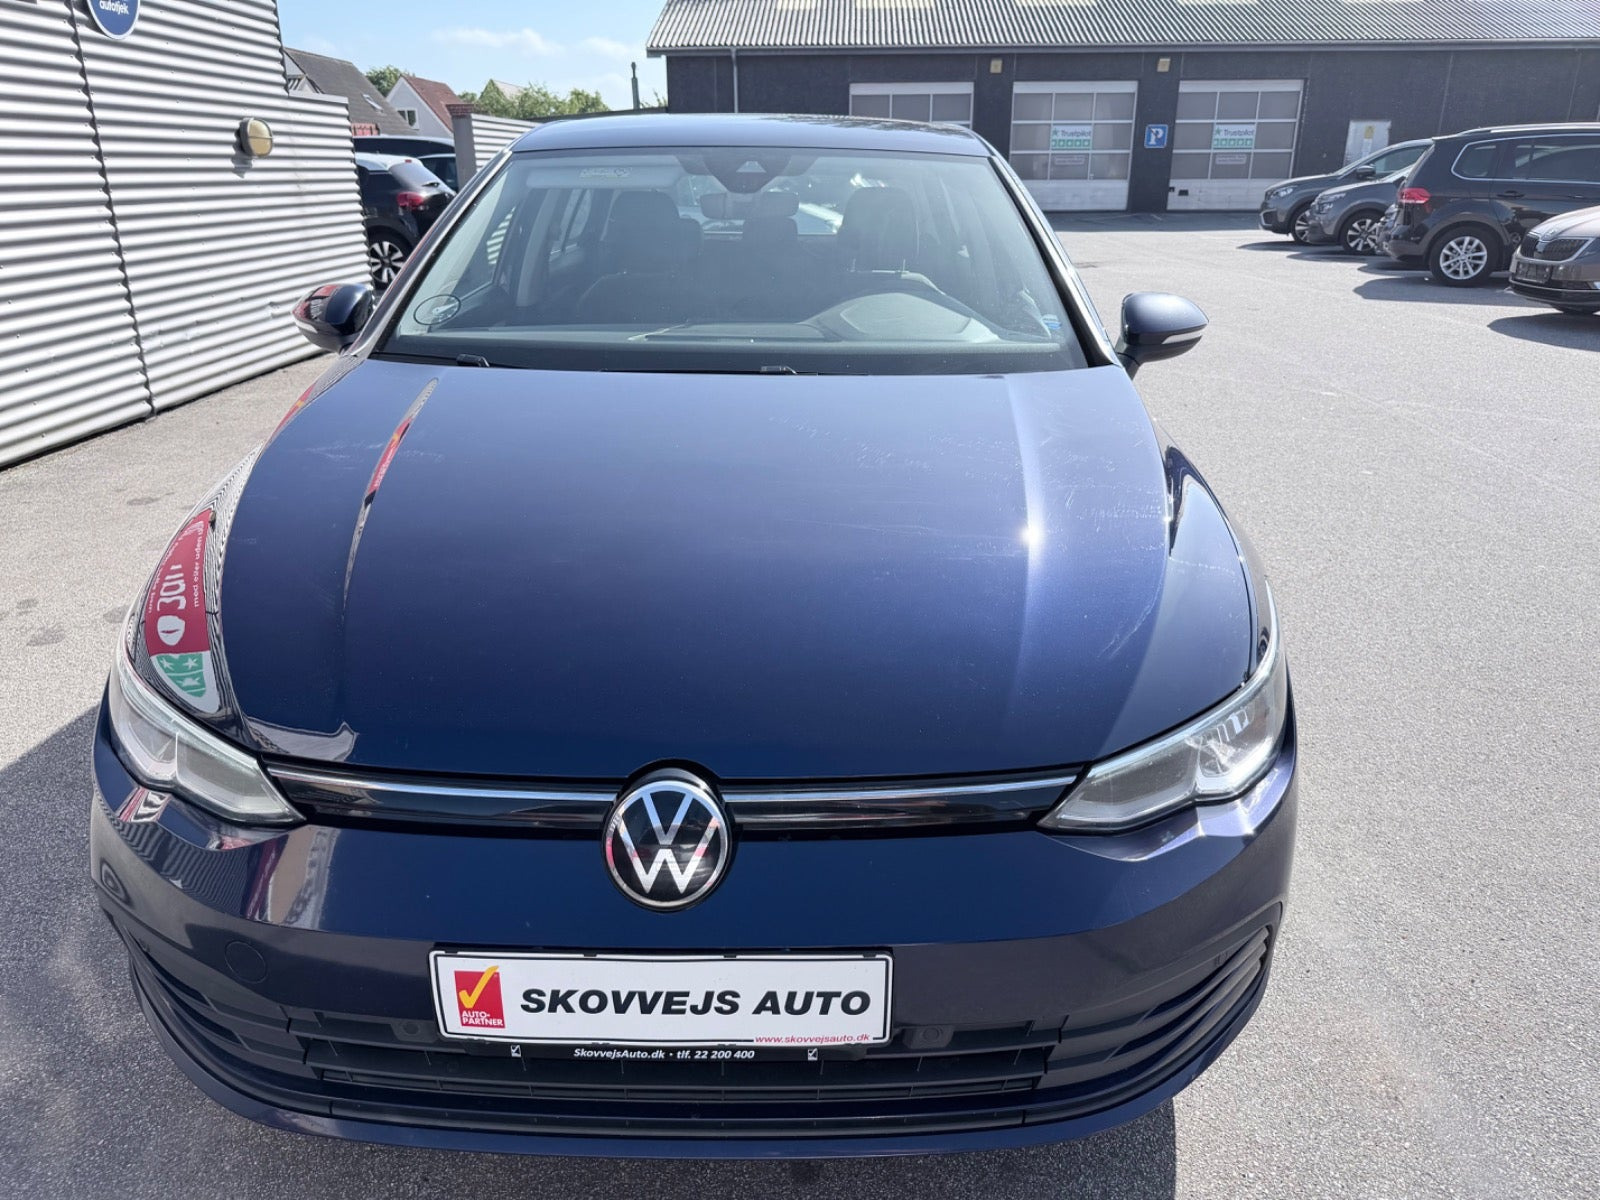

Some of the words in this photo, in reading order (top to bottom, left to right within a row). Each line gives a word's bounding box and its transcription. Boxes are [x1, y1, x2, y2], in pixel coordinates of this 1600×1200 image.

[99, 0, 129, 15] autotjek
[1061, 129, 1092, 138] Trustpilot
[1148, 128, 1164, 145] P
[1224, 129, 1255, 137] Trustpilot
[521, 988, 741, 1015] SKOVVEJS
[752, 990, 871, 1016] AUTO
[462, 1010, 491, 1019] AUTO-
[463, 1017, 503, 1026] PARTNER
[755, 1033, 870, 1044] www.skovvejsauto.dk
[573, 1048, 666, 1060] SkovvejsAuto.dk
[676, 1050, 691, 1060] tlf.
[693, 1050, 709, 1060] 22
[710, 1050, 732, 1060] 200
[733, 1050, 755, 1060] 400
